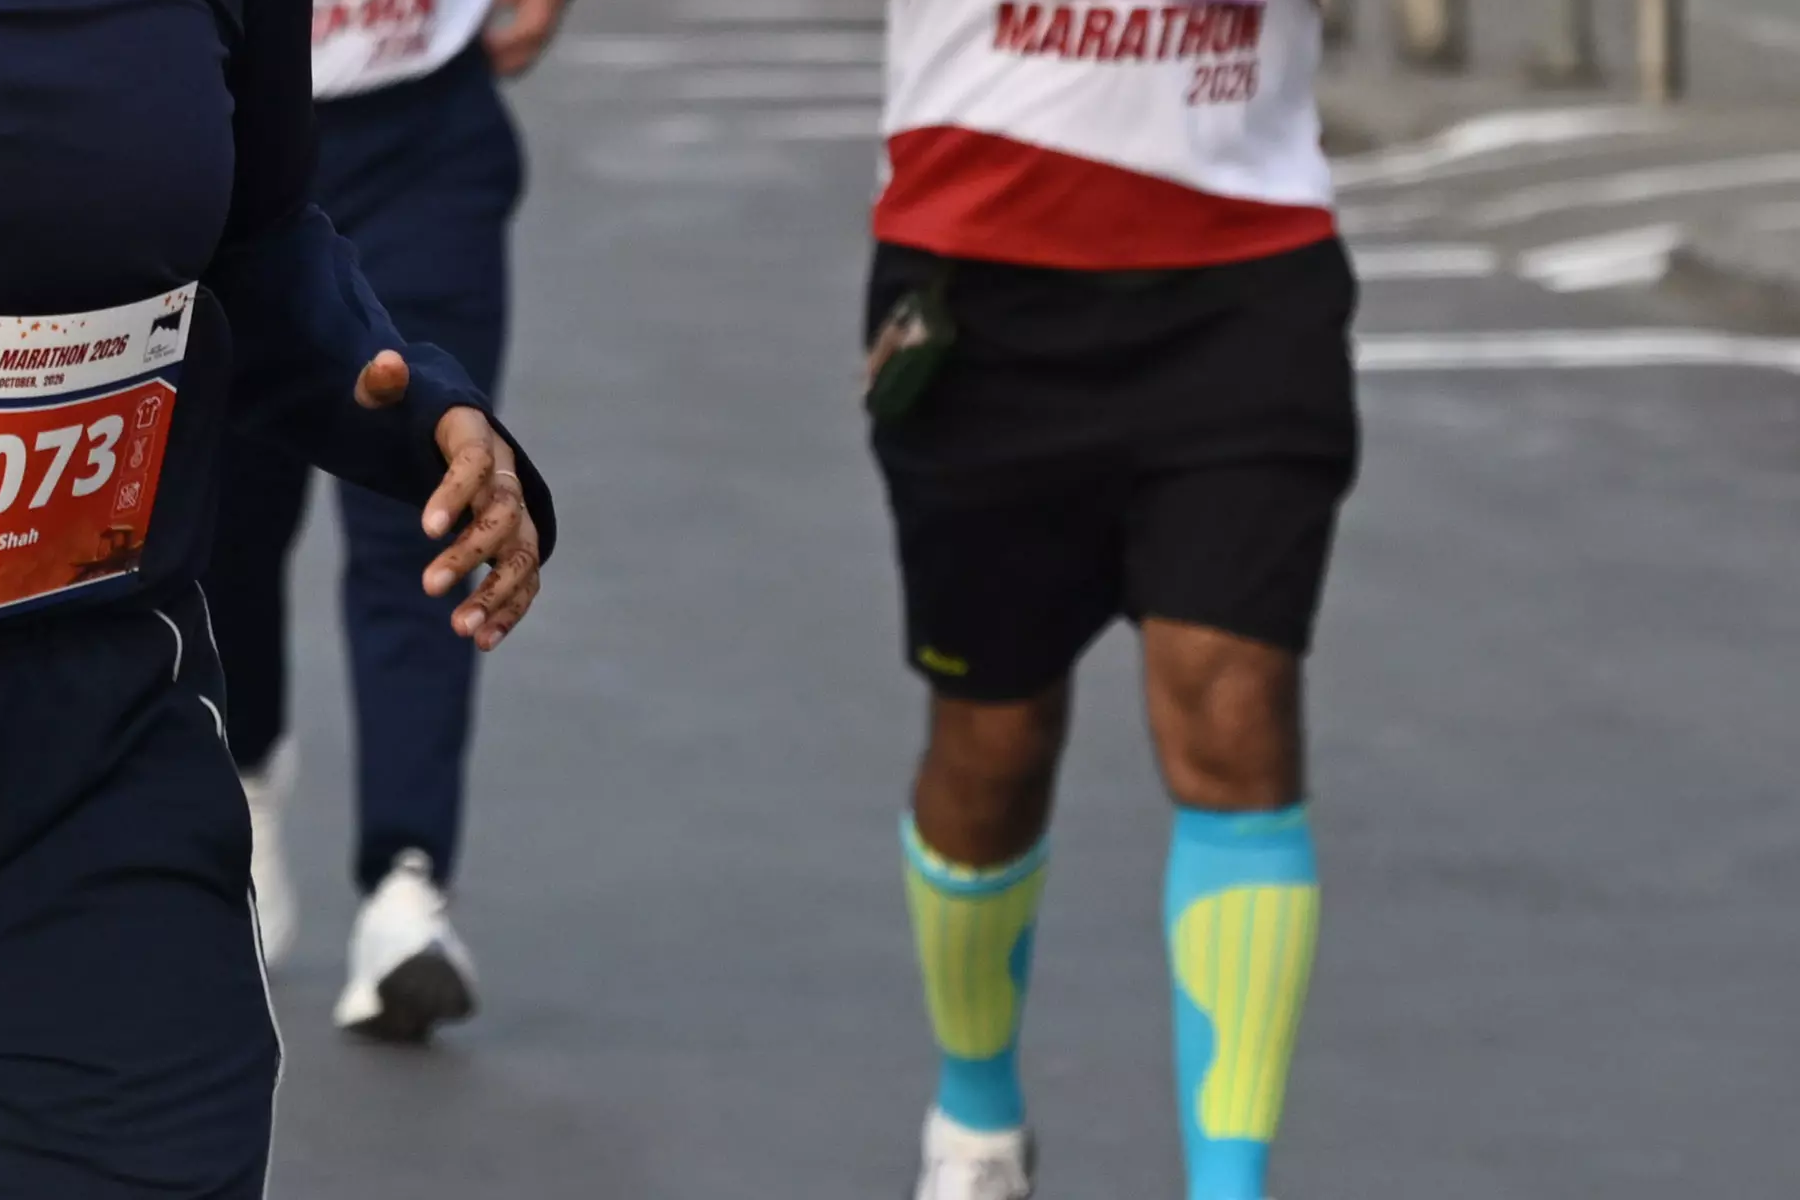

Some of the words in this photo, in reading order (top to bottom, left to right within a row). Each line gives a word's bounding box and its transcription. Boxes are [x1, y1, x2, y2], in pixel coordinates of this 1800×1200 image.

[995, 2, 1262, 60] MARATHON
[88, 334, 130, 362] 2026
[43, 373, 65, 387] 2026
